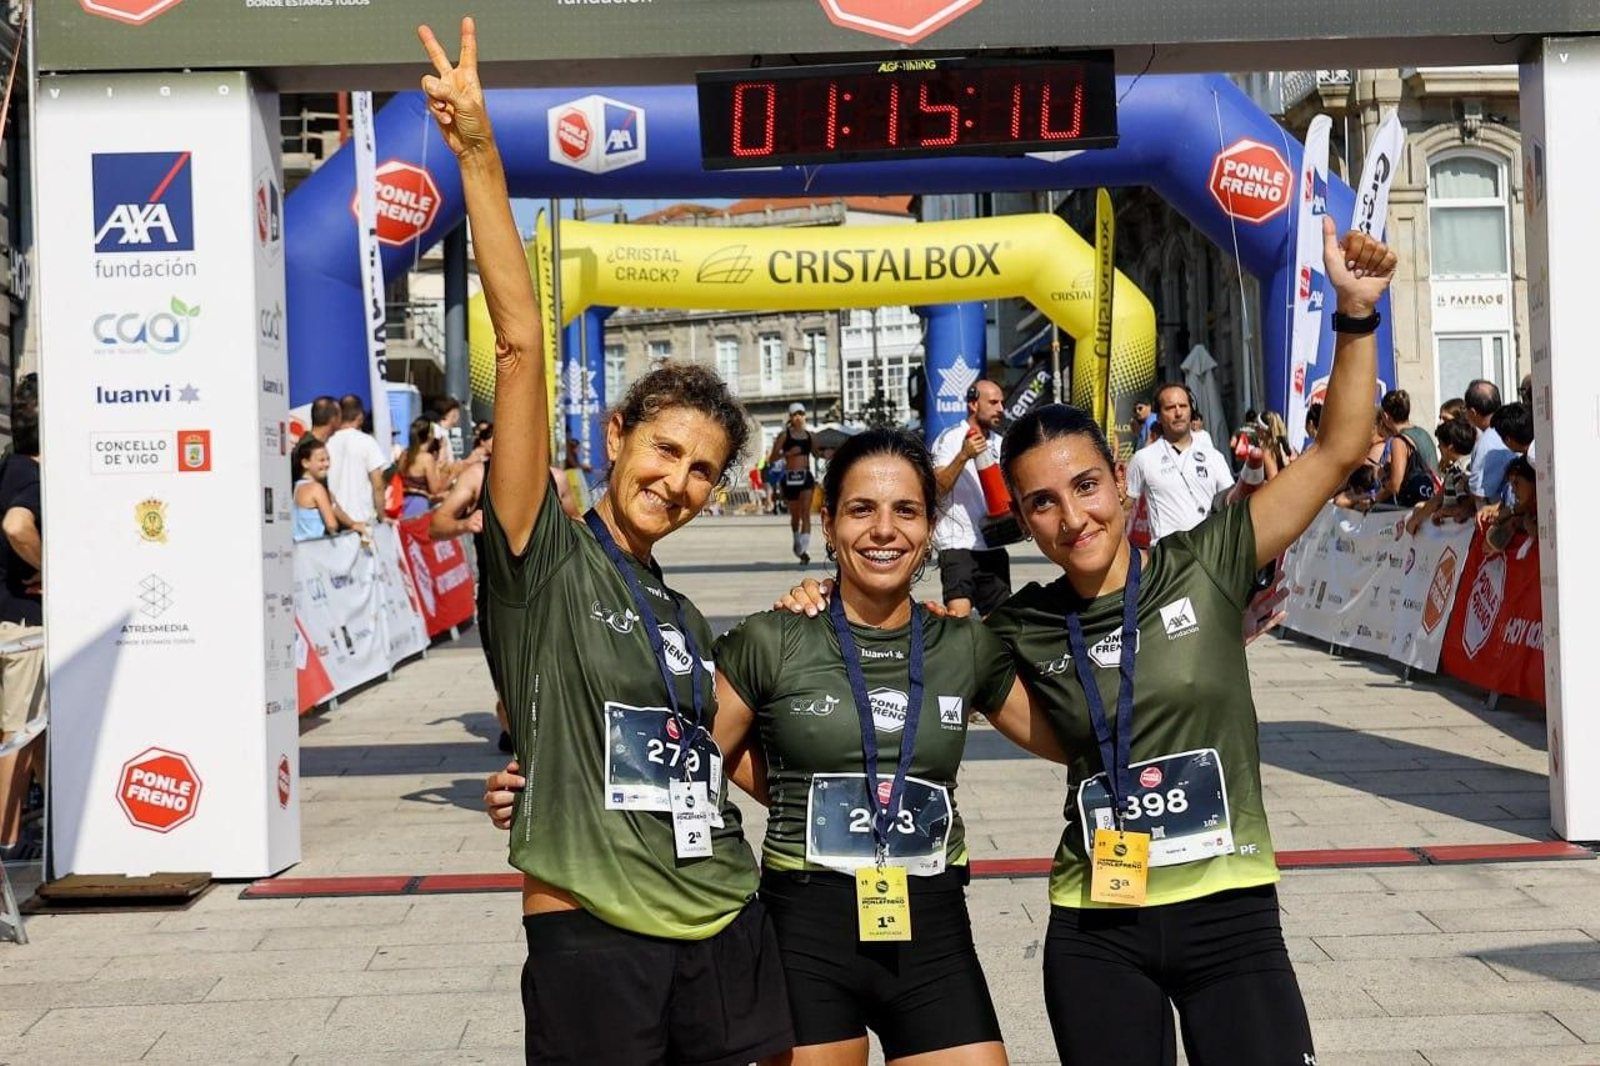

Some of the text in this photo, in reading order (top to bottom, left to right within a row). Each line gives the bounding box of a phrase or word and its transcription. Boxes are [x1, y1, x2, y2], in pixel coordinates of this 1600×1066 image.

[1222, 159, 1285, 186] PONLE
[1219, 175, 1282, 202] FRENO
[94, 202, 178, 245] AXA
[376, 199, 427, 227] RENO
[95, 257, 197, 278] fundación
[615, 265, 680, 283] CRACK?
[767, 241, 1001, 284] CRISTALBOX
[97, 384, 171, 404] luanvi
[96, 439, 167, 452] CONCELLO
[105, 453, 159, 465] DE VIGO
[121, 624, 190, 634] ATRESMEDIA
[1168, 626, 1200, 641] fundación
[662, 639, 690, 666] RENO
[861, 648, 894, 659] luanvi
[1095, 644, 1122, 654] FREN
[131, 768, 192, 795] PONLE
[127, 785, 188, 812] FRENO
[1125, 788, 1189, 821] 398
